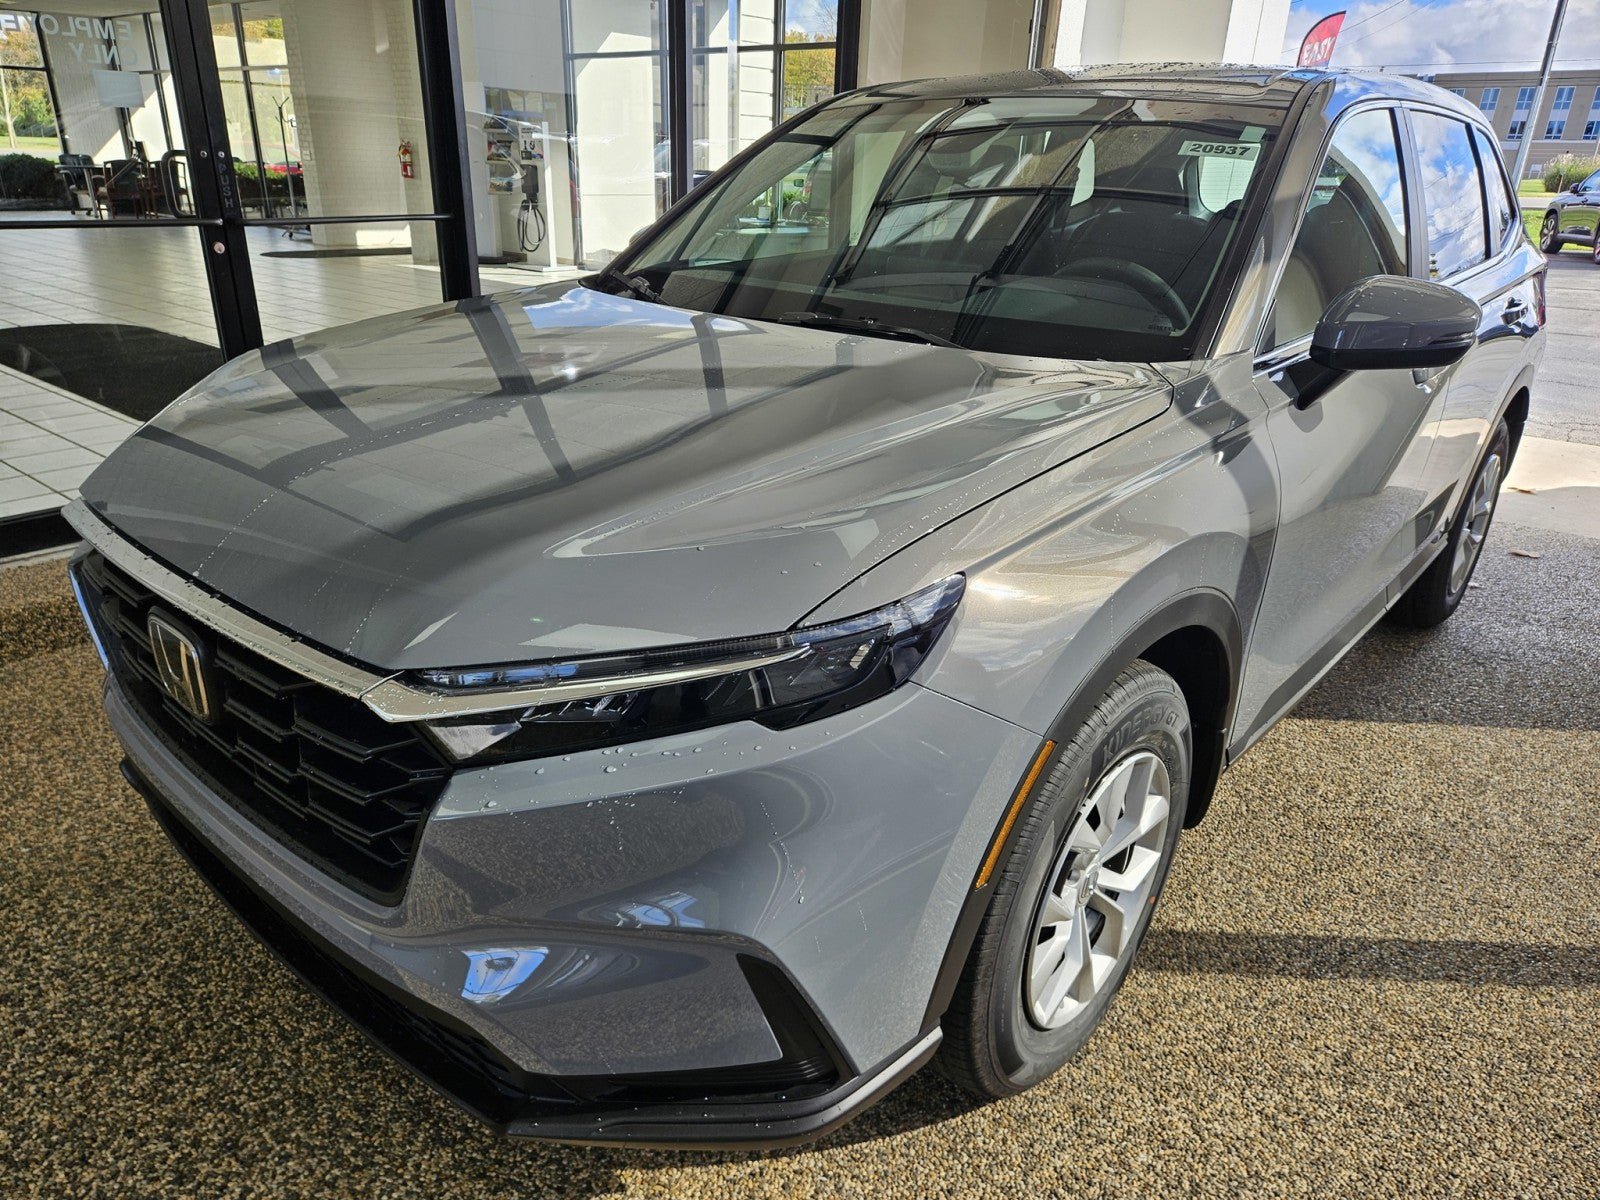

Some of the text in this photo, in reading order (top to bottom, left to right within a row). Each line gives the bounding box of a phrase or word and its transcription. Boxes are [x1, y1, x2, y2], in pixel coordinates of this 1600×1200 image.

[1189, 143, 1251, 156] 20937
[218, 163, 234, 208] PUSH
[1166, 710, 1179, 727] GT
